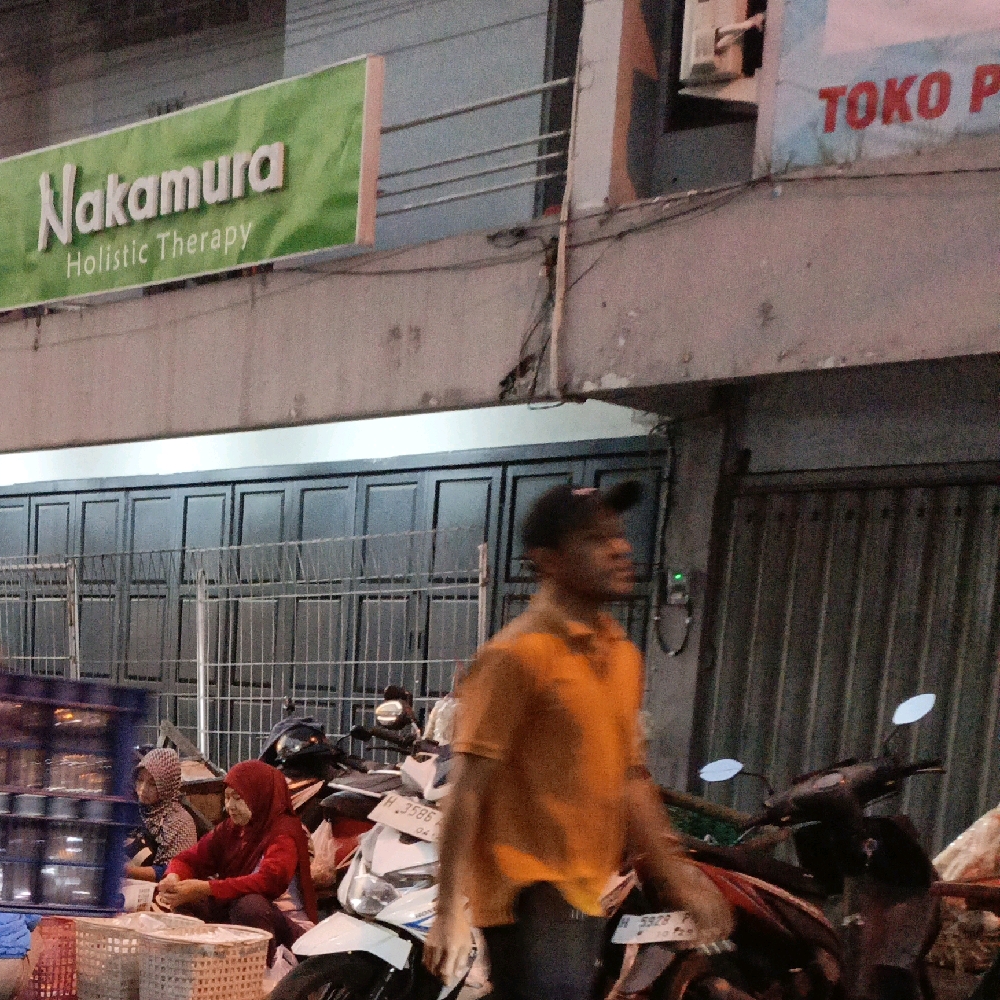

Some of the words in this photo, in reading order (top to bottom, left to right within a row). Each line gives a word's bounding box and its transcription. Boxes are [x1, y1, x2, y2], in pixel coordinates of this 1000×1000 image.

[818, 70, 952, 134] TOKO
[37, 140, 285, 252] Nakamura
[66, 241, 148, 279] Holistic
[156, 220, 253, 259] Therapy
[383, 796, 397, 807] H
[400, 803, 436, 822] 3586
